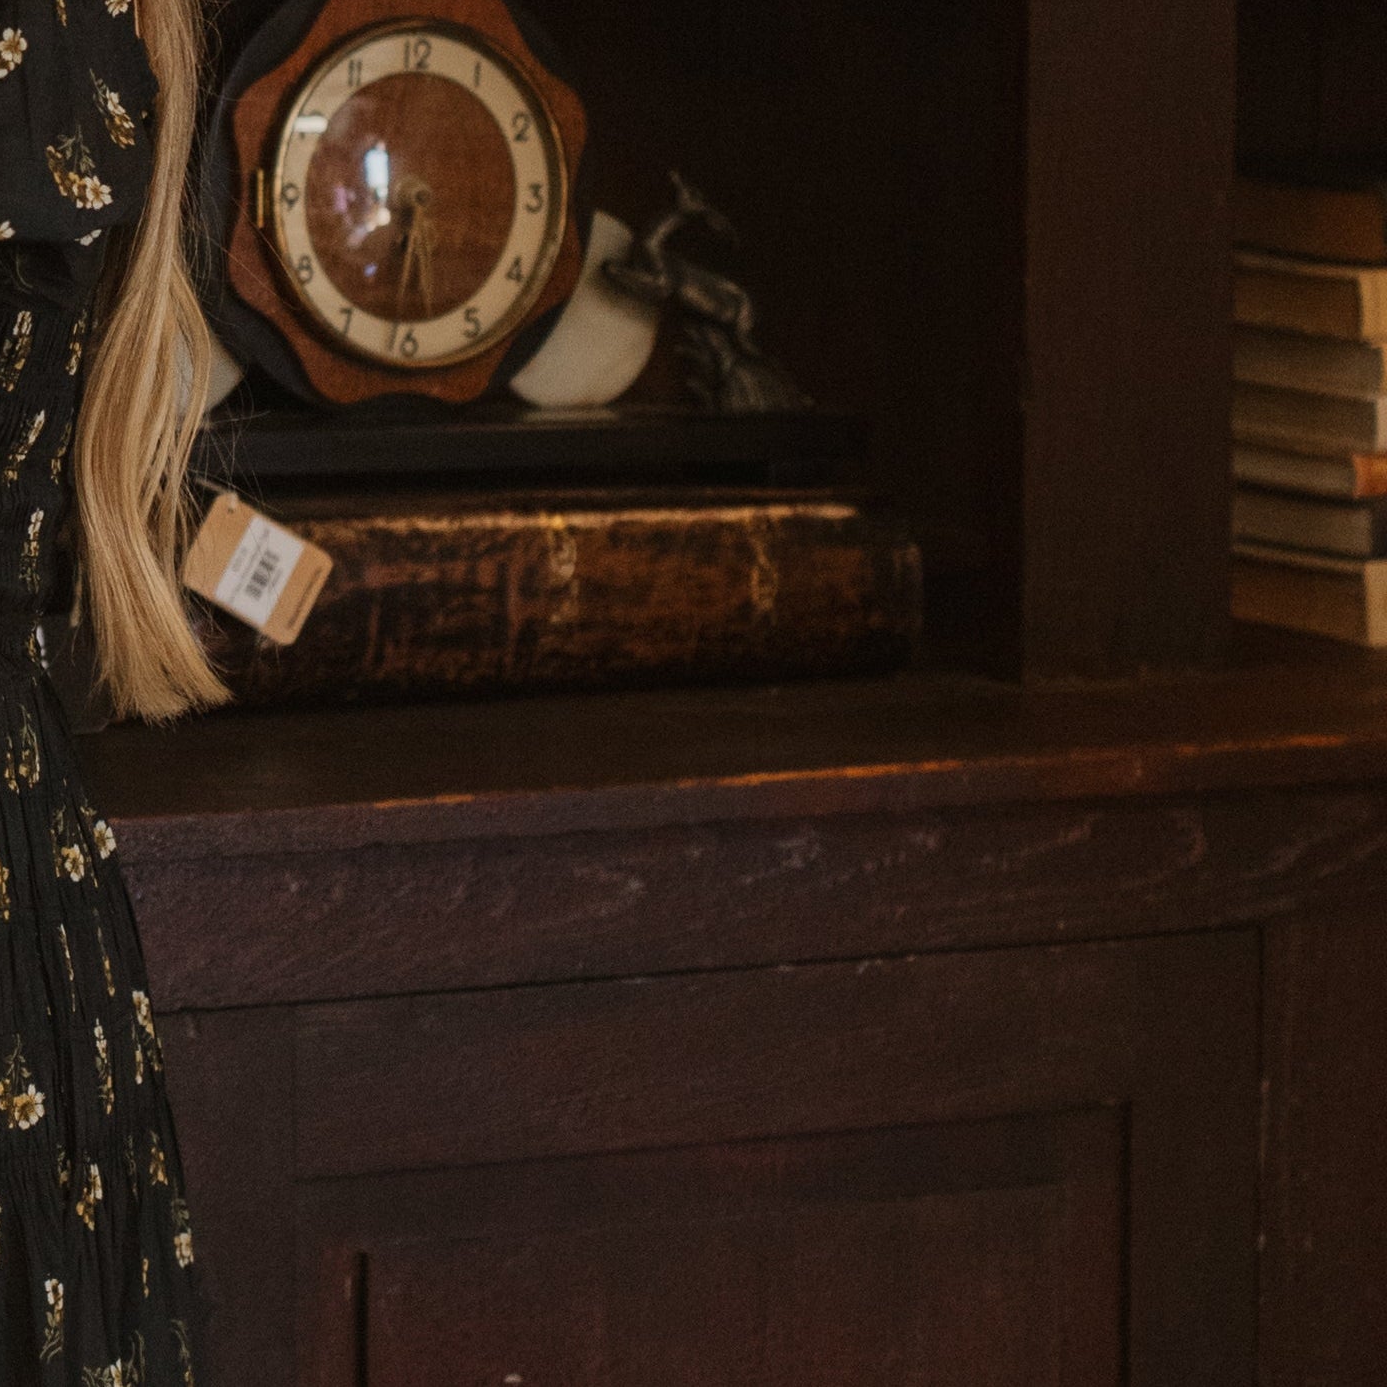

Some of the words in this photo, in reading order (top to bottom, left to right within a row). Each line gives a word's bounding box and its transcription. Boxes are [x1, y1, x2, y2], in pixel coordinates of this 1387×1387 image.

[404, 40, 432, 72] 12
[348, 59, 363, 87] 11
[474, 62, 483, 87] 1
[512, 114, 531, 142] 2
[281, 183, 300, 210] 9
[527, 183, 545, 213] 3
[297, 255, 314, 285] 8
[505, 256, 525, 283] 4
[339, 309, 354, 337] 7
[464, 313, 482, 339] 5
[400, 328, 419, 358] 6
